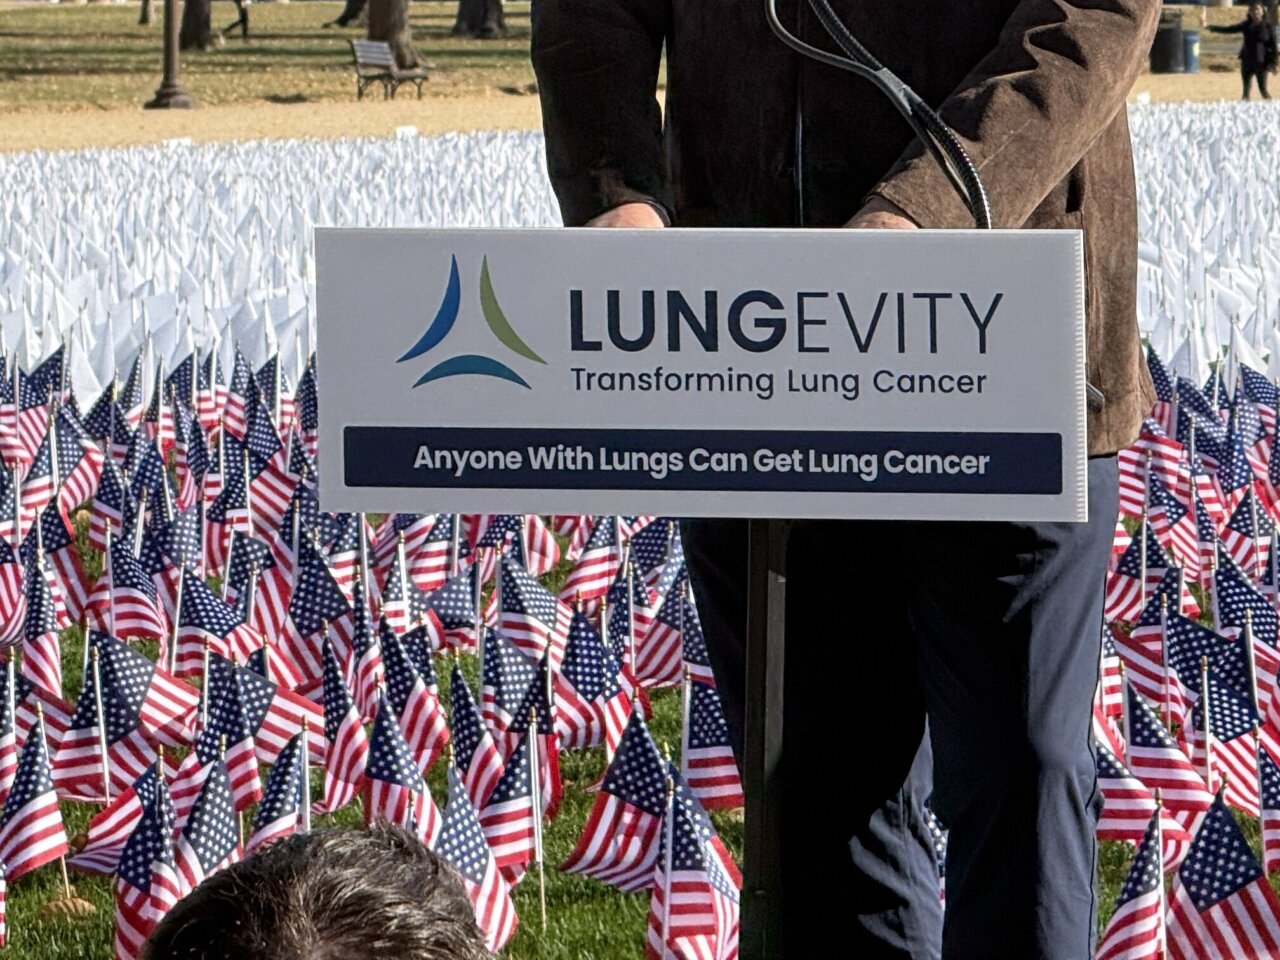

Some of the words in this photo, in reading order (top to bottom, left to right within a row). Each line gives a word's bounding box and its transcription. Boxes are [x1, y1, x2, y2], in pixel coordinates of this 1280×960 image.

[569, 289, 1004, 355] LUNGEVITY
[570, 366, 774, 401] Transforming
[788, 369, 860, 401] Lung
[872, 369, 987, 394] Cancer
[413, 445, 523, 477] Anyone
[527, 443, 594, 471] With
[599, 447, 684, 480] Lungs
[688, 447, 748, 472] Can
[753, 448, 804, 473] Get
[808, 449, 878, 482] Lung
[883, 449, 990, 475] Cancer
